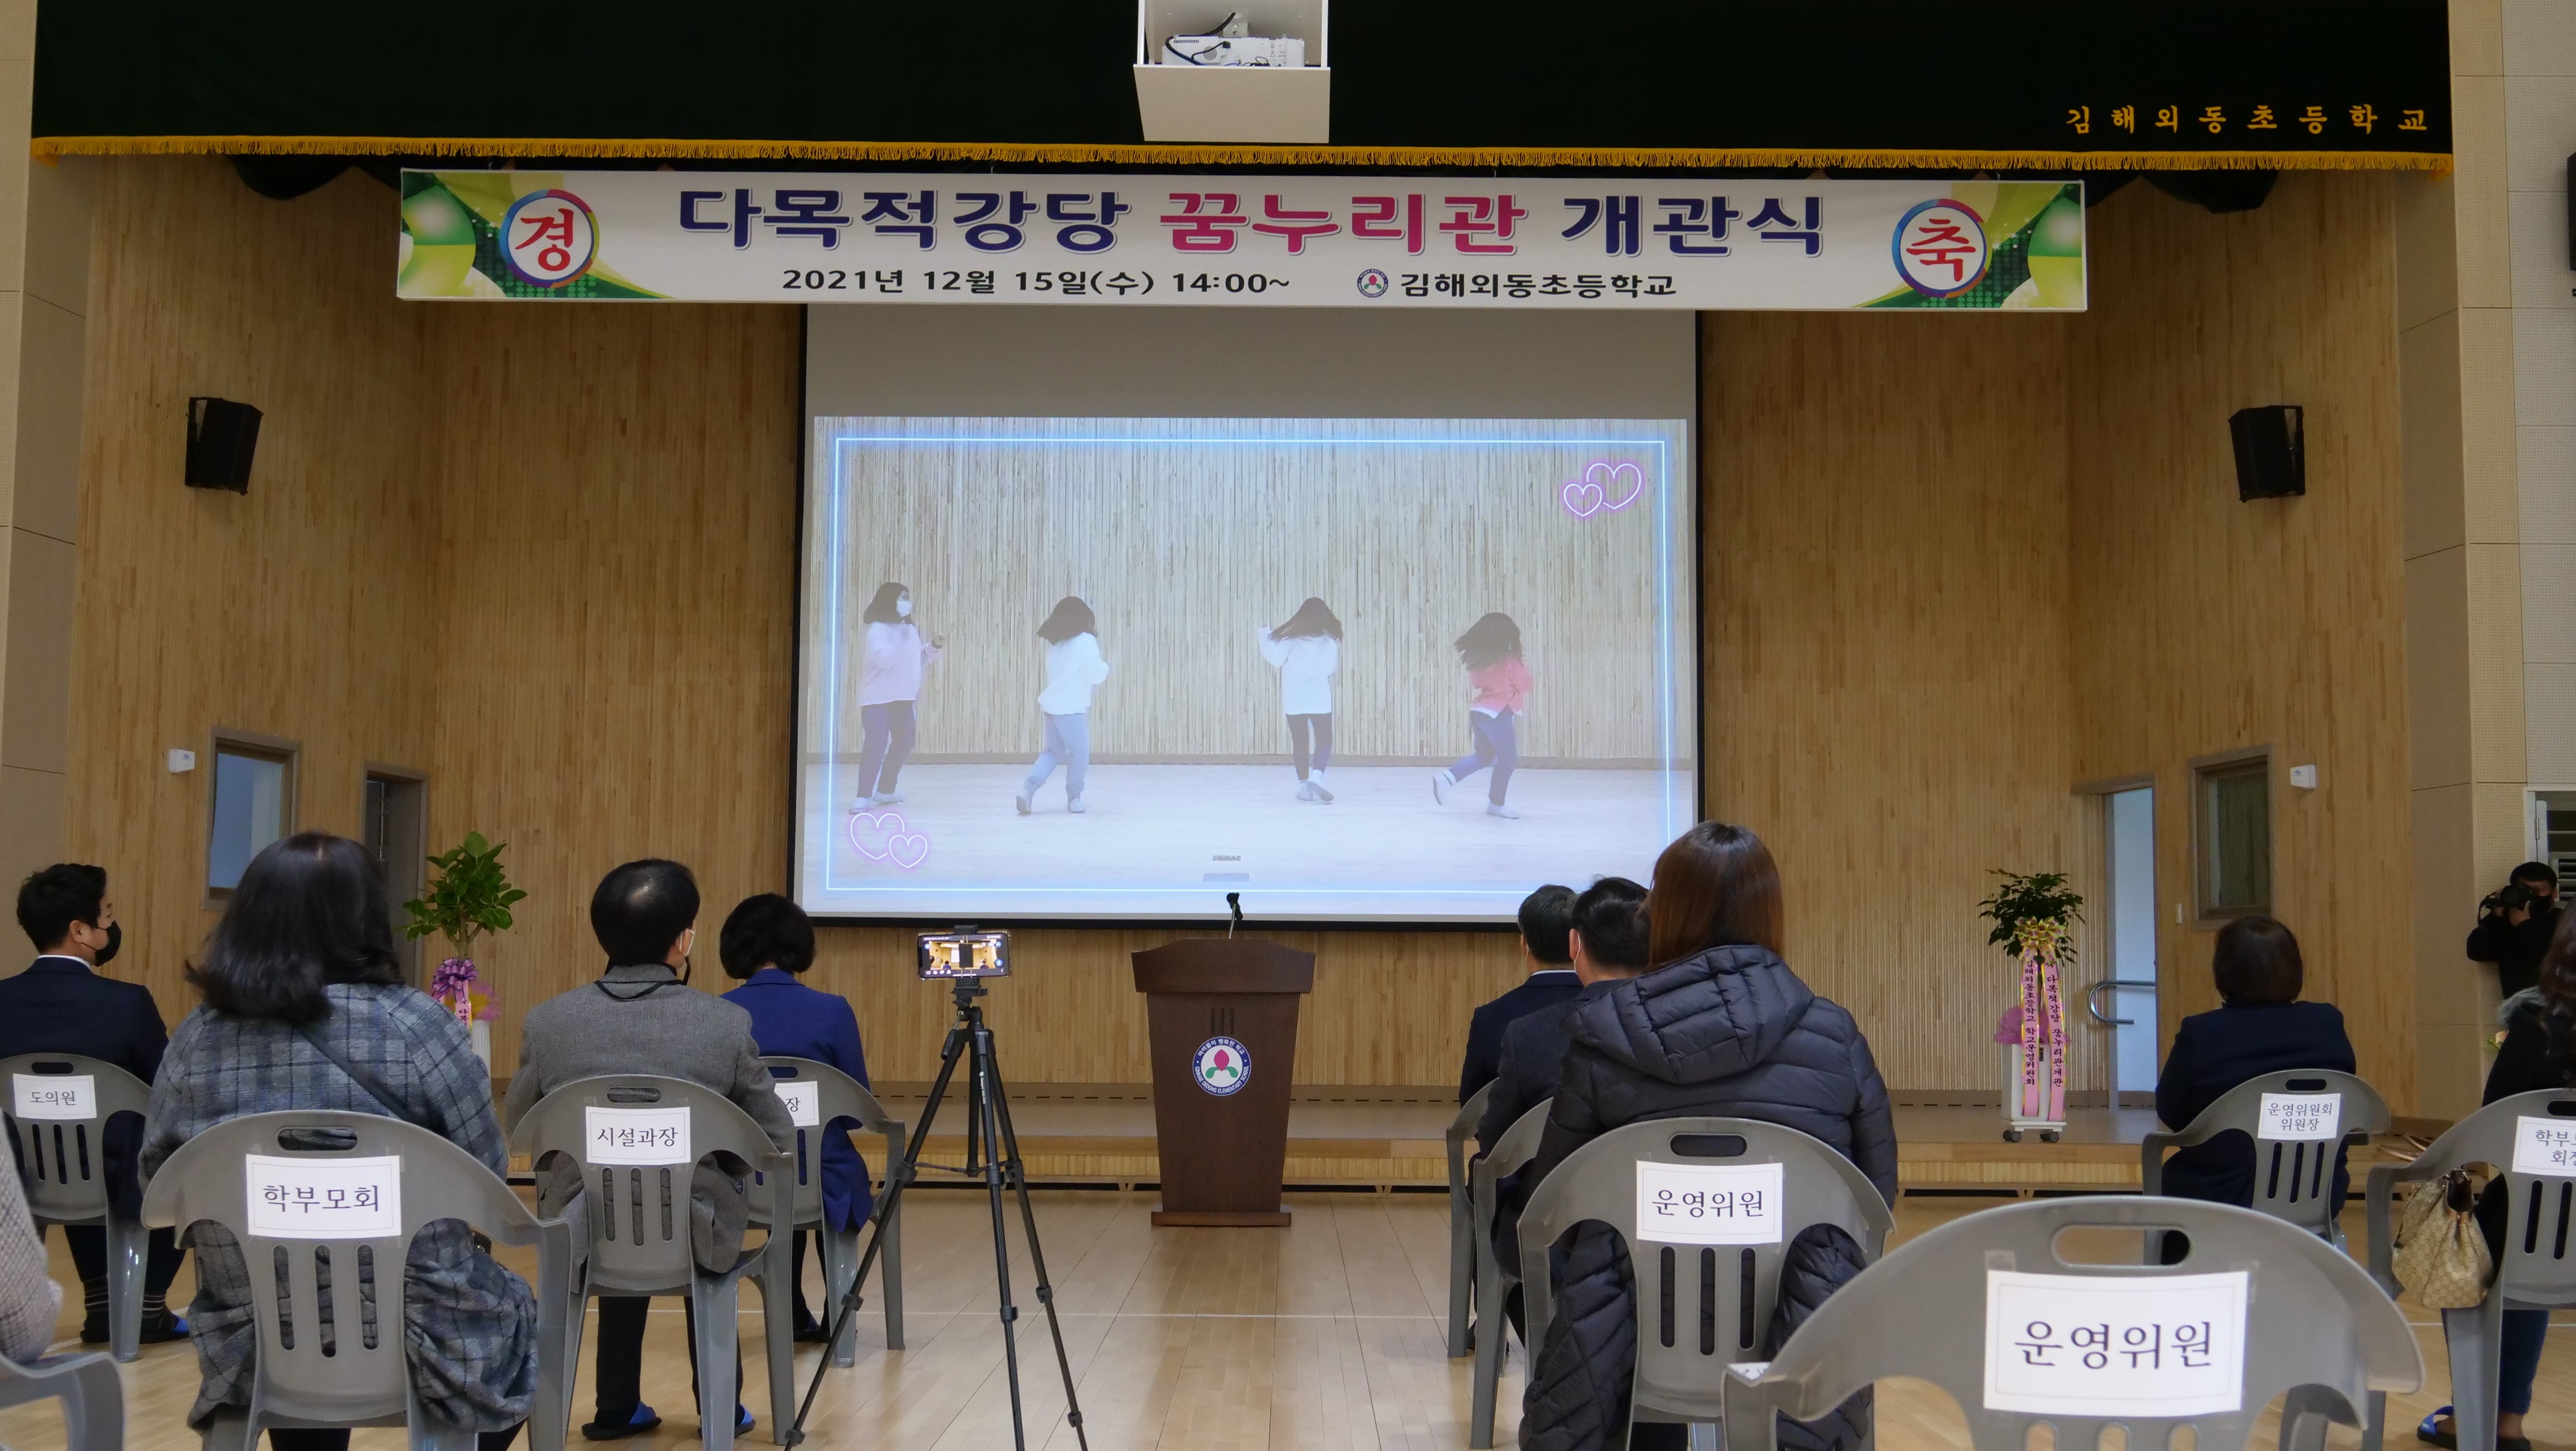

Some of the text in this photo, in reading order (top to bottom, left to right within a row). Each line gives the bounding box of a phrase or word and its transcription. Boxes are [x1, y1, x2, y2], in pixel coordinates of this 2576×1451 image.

[2066, 105, 2427, 134] 김해외동초등학교
[680, 188, 1824, 258] 다목적강당 꿈누리관 개관식
[516, 208, 574, 272] 경
[1906, 218, 1976, 282] 축
[782, 269, 1290, 296] 2021년 12월 15일(수) 14:00~
[1400, 273, 1677, 298] 김해외동초등학교
[2046, 975, 2061, 1023] 다목적강당
[458, 1009, 469, 1026] 다목
[1236, 1044, 1245, 1055] 학교
[2025, 1028, 2036, 1086] 학교운영위원회
[1217, 1080, 1243, 1093] ELEMENTARY
[1240, 1065, 1249, 1082] SCHOOL
[30, 1091, 76, 1106] 도의원
[2267, 1103, 2332, 1117] 운영위원회
[597, 1127, 678, 1147] 시설과장
[2280, 1118, 2320, 1131] 위원장
[263, 1185, 378, 1213] 학부모회
[1652, 1190, 1764, 1218] 운영위원
[2014, 1321, 2211, 1370] 운영위원
